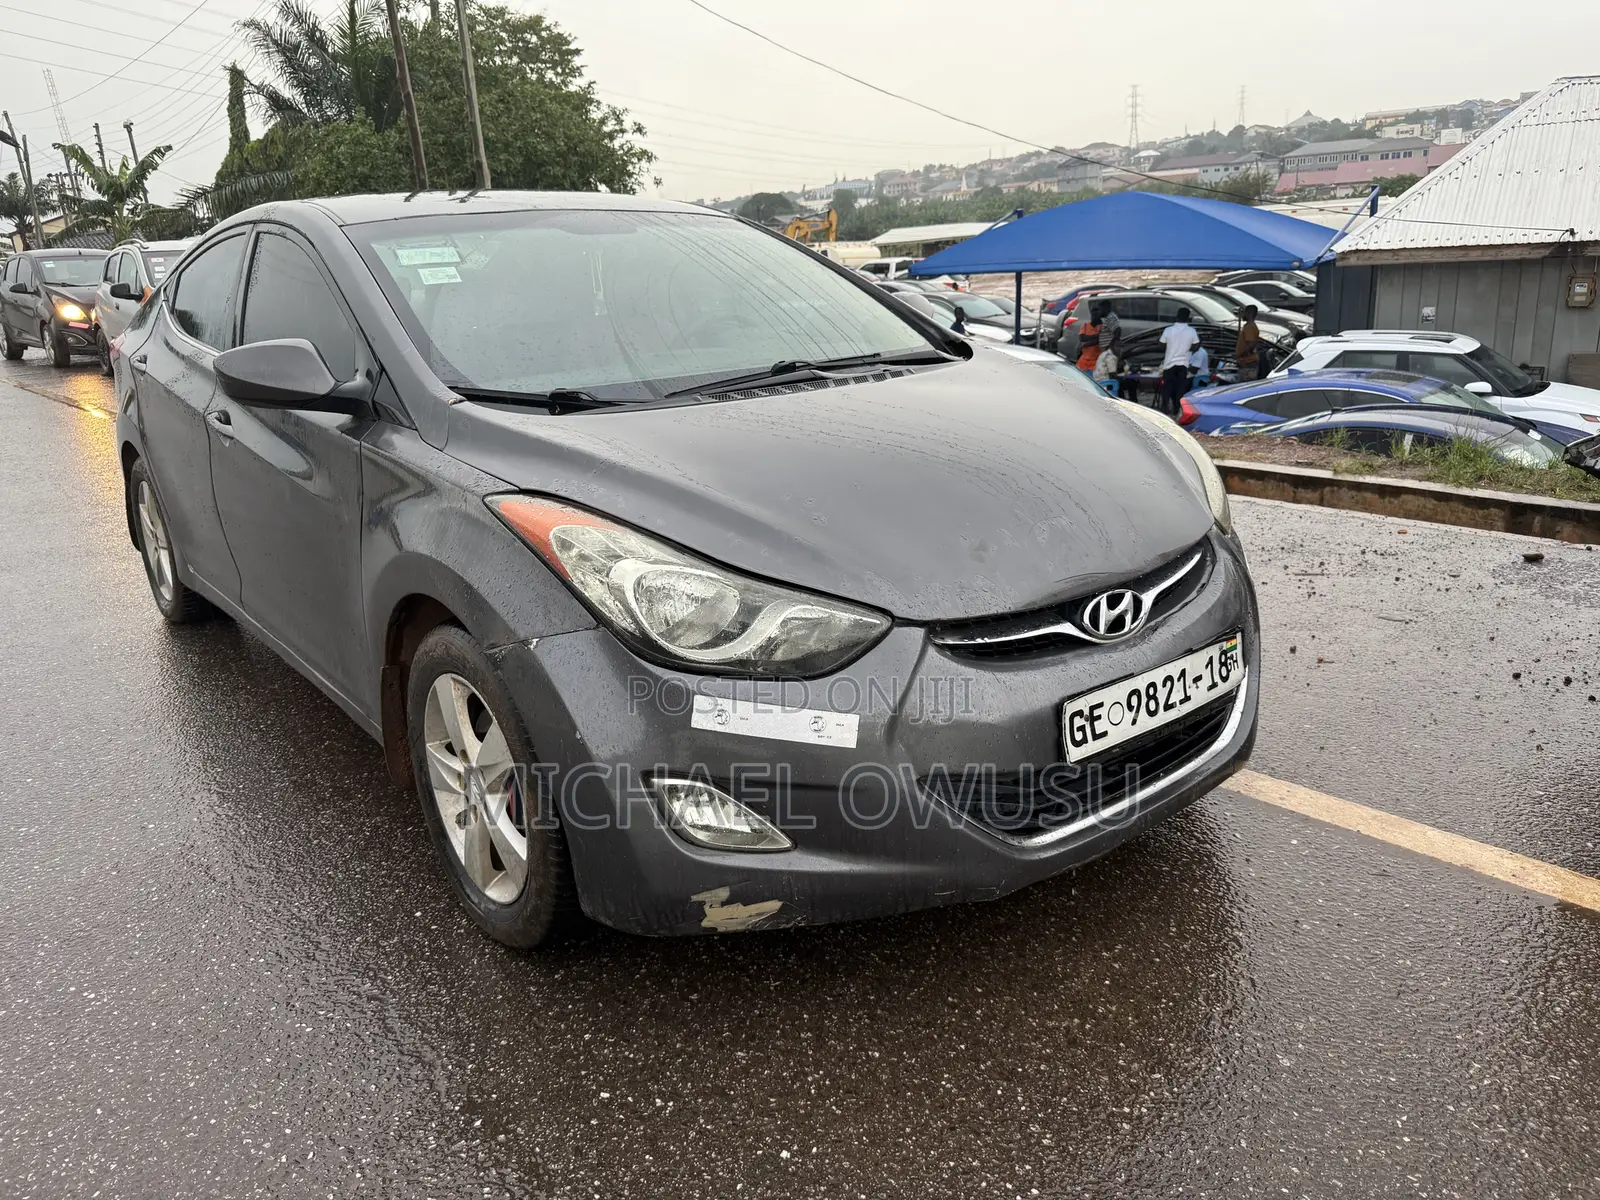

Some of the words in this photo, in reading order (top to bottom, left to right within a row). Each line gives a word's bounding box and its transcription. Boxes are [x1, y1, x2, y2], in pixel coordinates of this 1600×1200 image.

[1226, 653, 1239, 672] GH
[1068, 702, 1108, 747] GE
[1126, 650, 1230, 726] 9821-18
